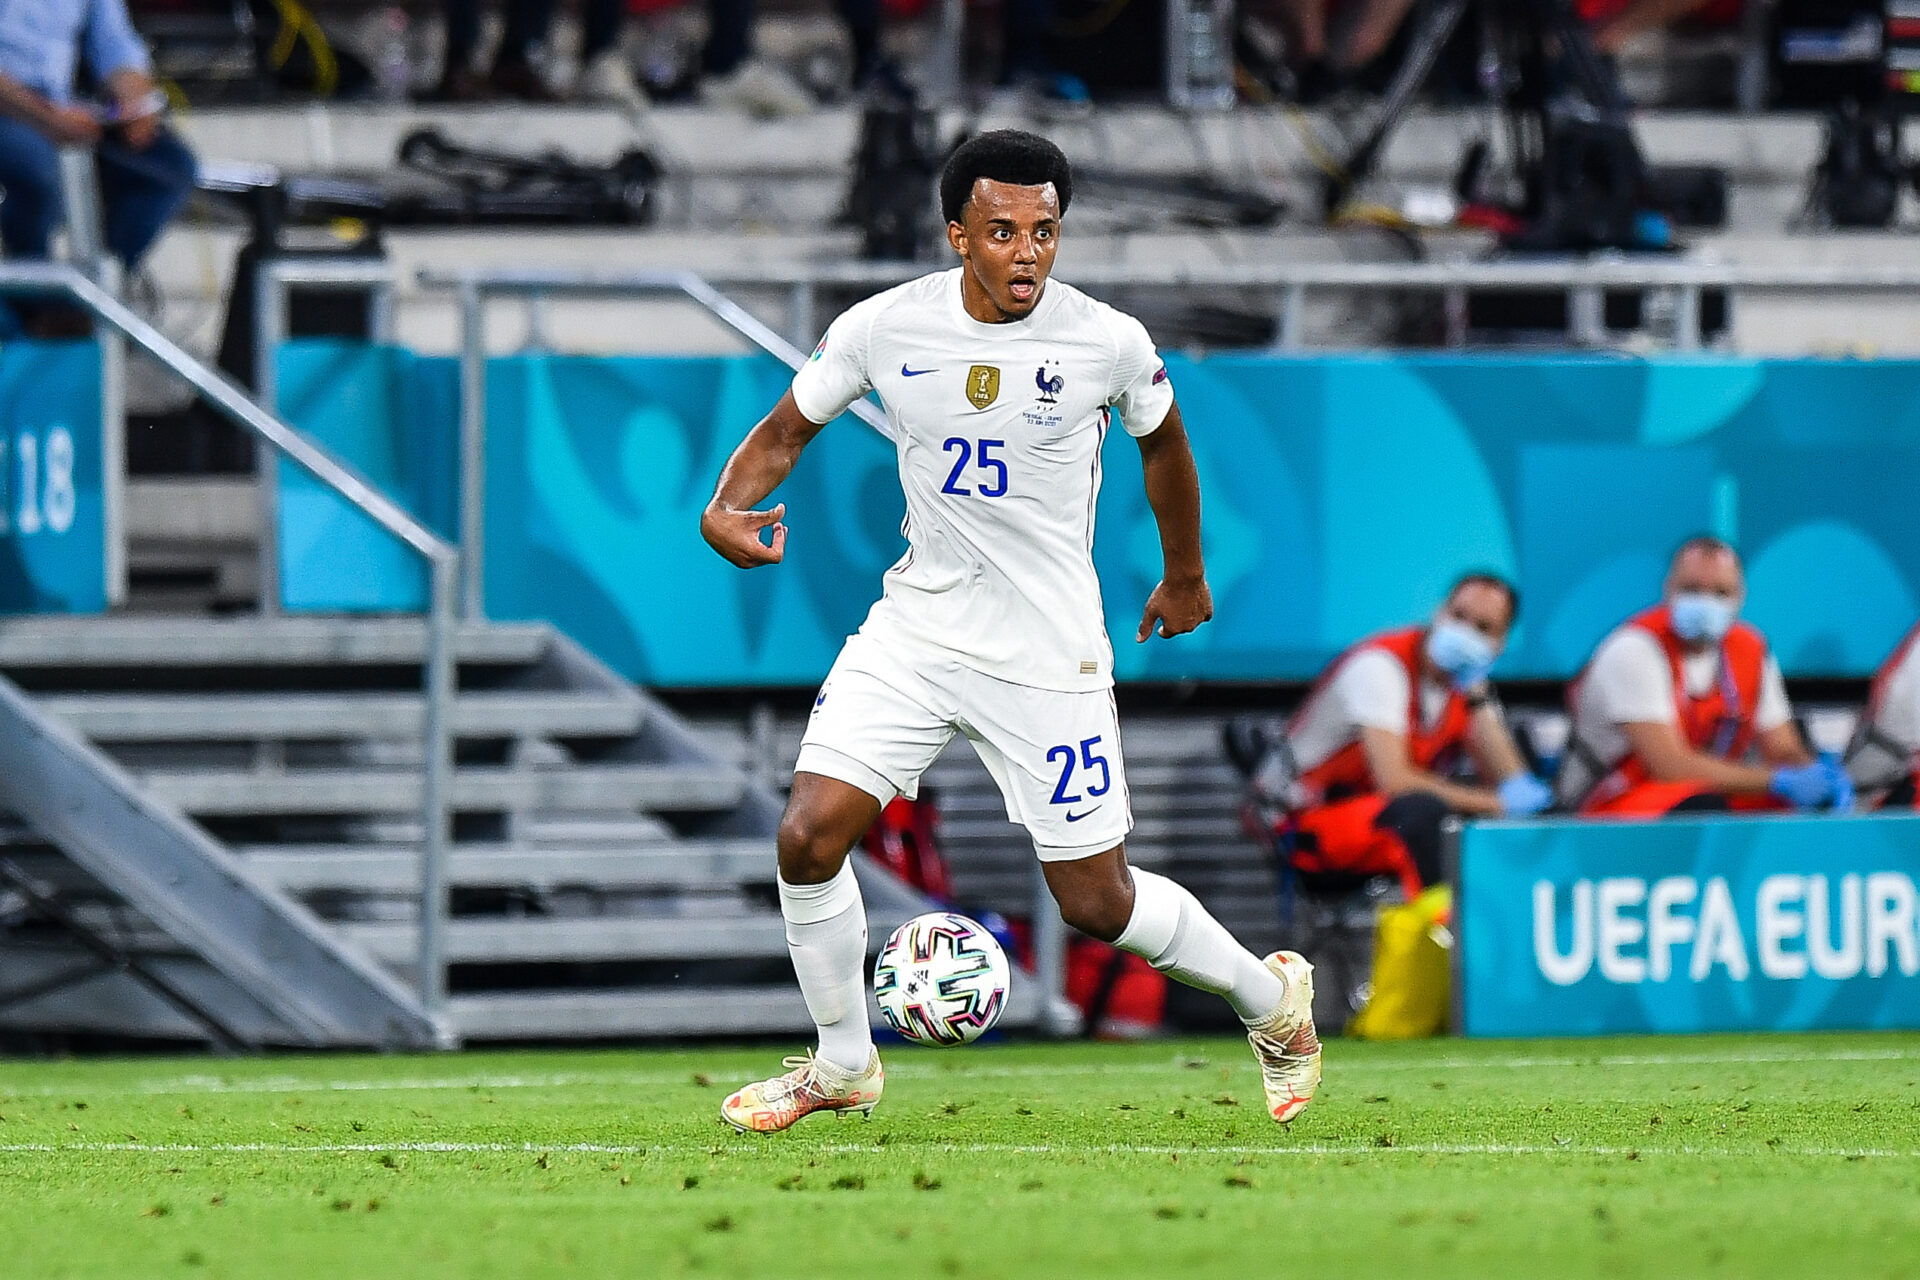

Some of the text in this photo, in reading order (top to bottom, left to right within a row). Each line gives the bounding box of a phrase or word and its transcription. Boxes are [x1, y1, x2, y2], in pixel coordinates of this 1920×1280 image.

[0, 427, 75, 534] 18
[941, 437, 1008, 498] 25
[1046, 734, 1111, 805] 25
[1532, 871, 1920, 986] UEFA EUR
